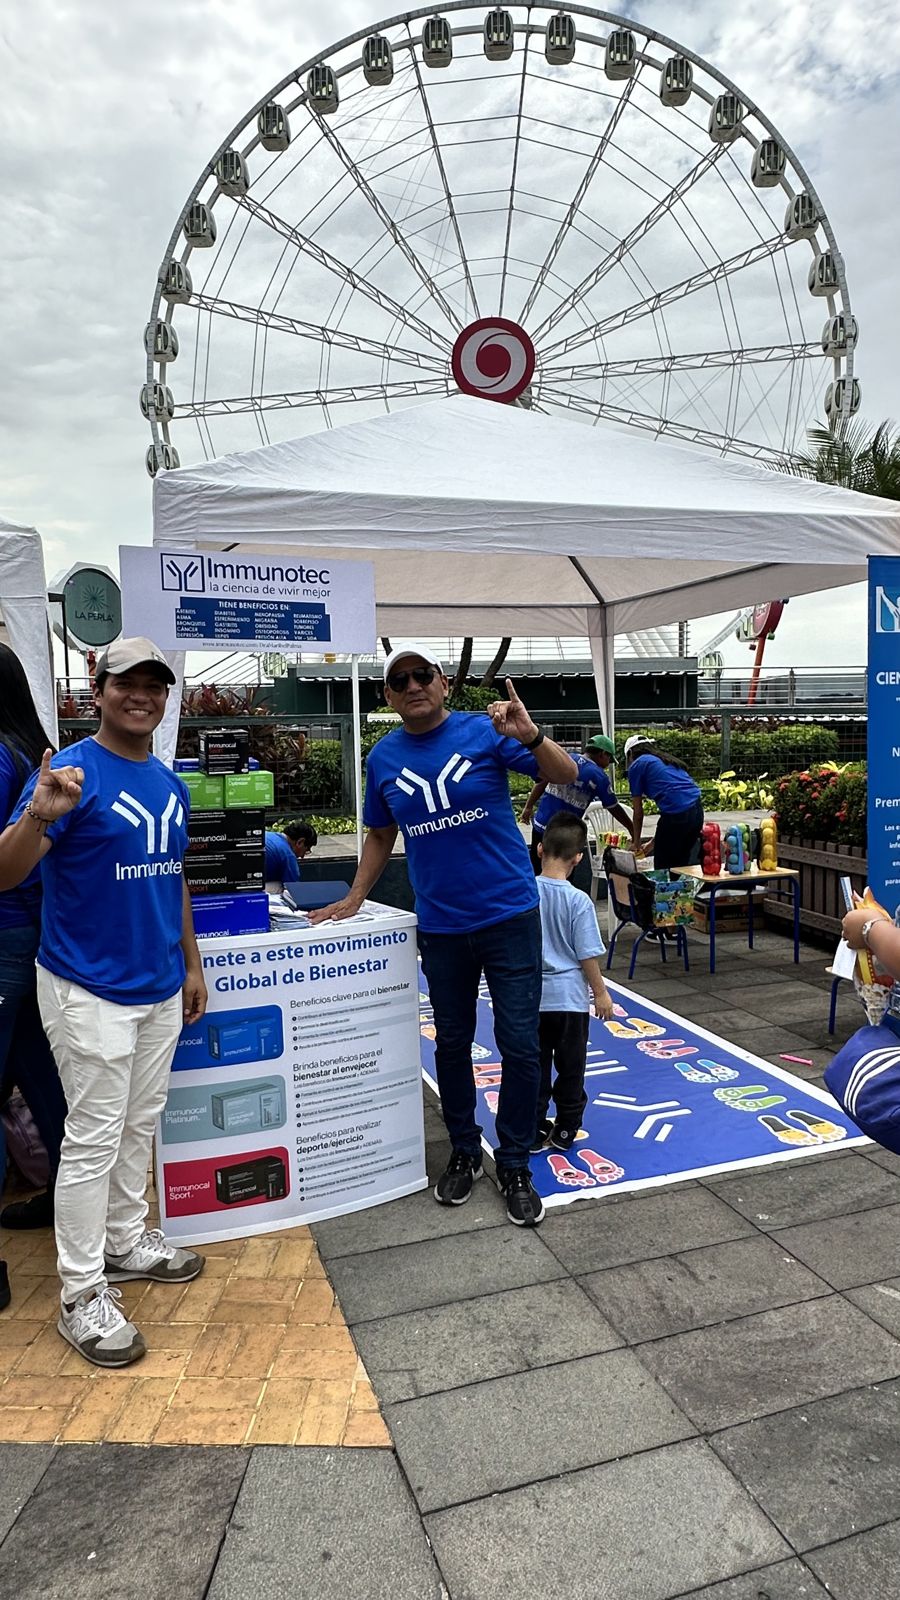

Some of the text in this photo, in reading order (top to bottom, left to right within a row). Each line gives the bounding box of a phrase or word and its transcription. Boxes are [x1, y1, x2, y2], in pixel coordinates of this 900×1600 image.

[208, 558, 330, 584] Immunotec
[210, 582, 331, 599] la ciencia de vivir mejor
[75, 610, 114, 622] LA PERLA
[239, 602, 278, 610] BENEFICIOS
[116, 858, 182, 880] Immunote
[188, 876, 227, 886] Immunocal
[203, 930, 408, 968] nete a este movimiento
[215, 957, 388, 992] Global de Bienestar
[290, 996, 332, 1008] Beneficios
[332, 992, 352, 1003] clave
[353, 990, 370, 1001] para
[378, 982, 410, 995] bienestar
[293, 1048, 383, 1072] Brinda beneficios para el
[293, 1060, 378, 1082] bienestar al envejecer
[165, 1106, 206, 1118] Immunocal
[296, 1120, 382, 1145] Beneficios para realizar
[296, 1134, 364, 1154] deporte/ejercicio
[169, 1181, 210, 1193] Immunocal
